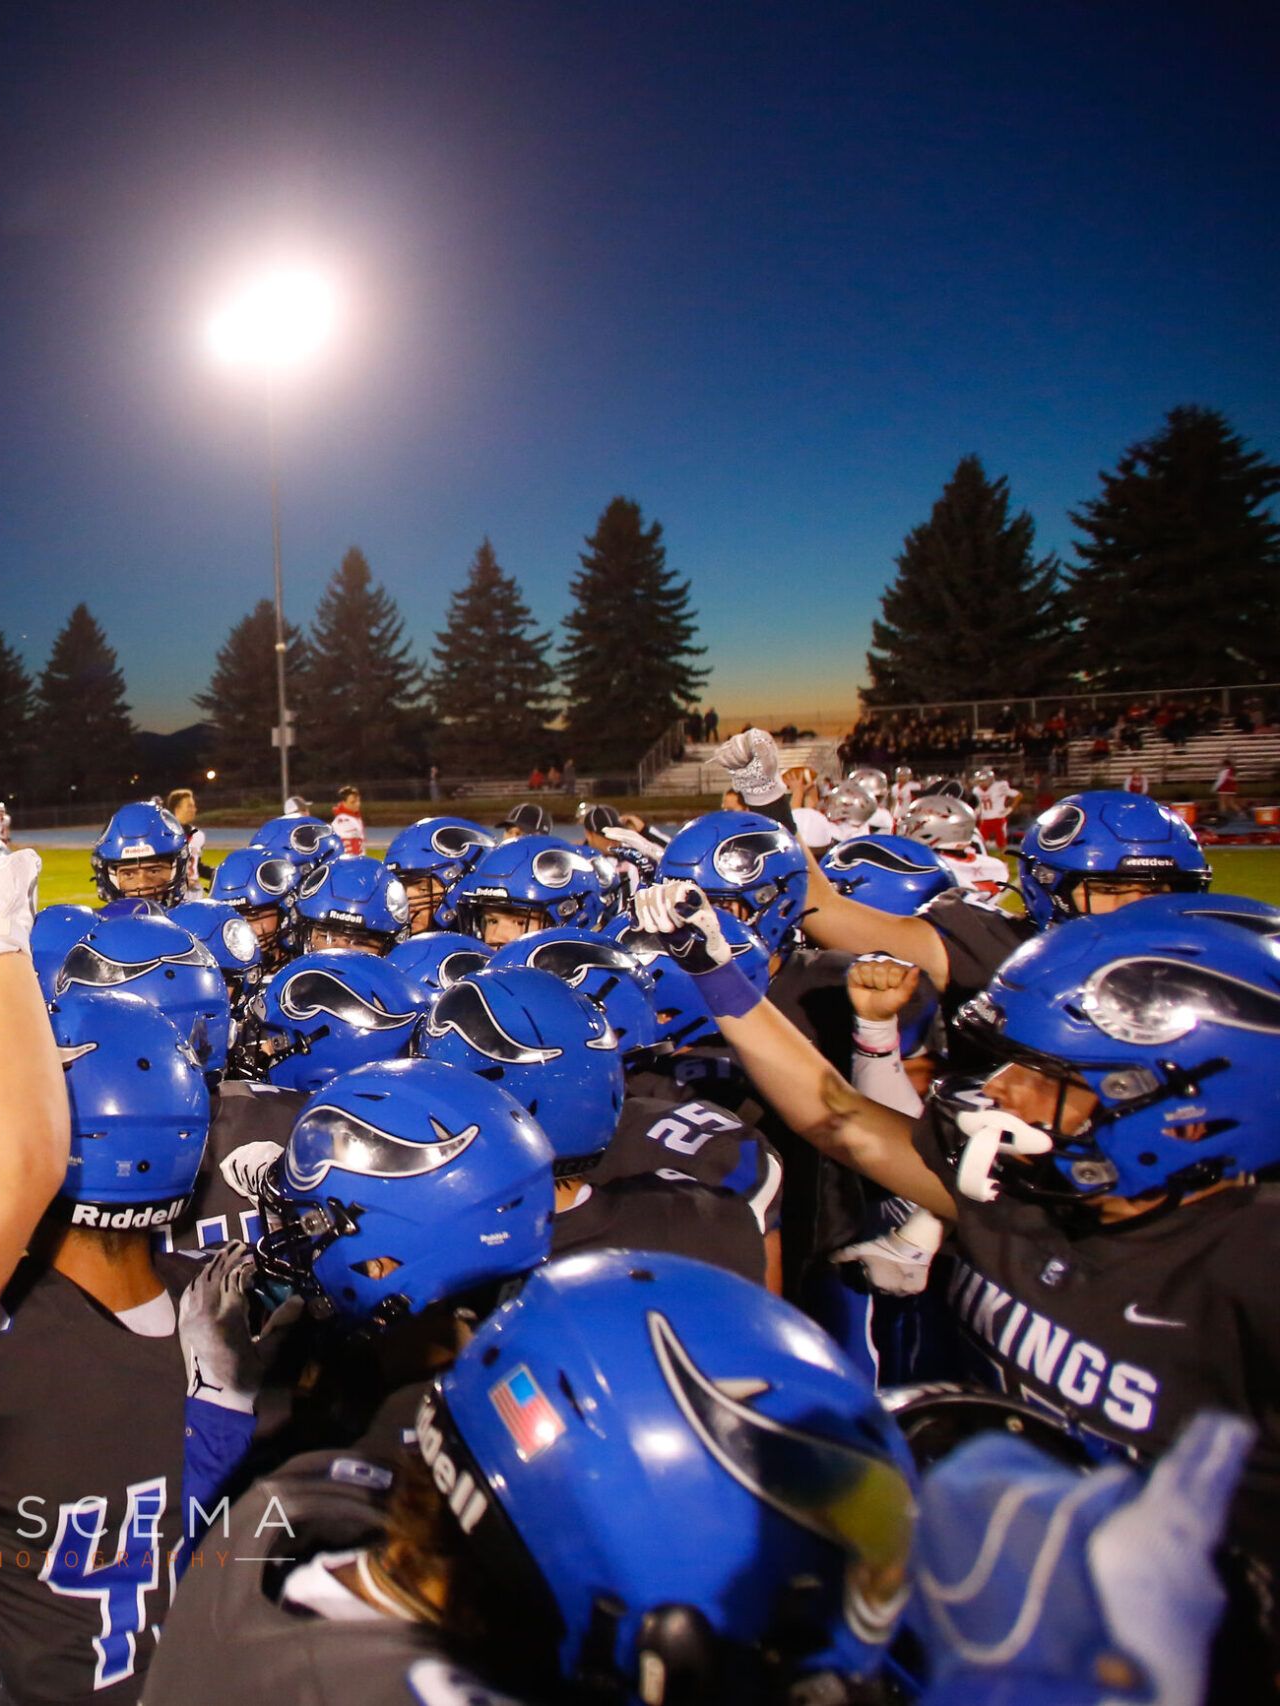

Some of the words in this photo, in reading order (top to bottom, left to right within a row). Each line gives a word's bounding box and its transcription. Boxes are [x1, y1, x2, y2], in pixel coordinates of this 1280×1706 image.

[329, 910, 363, 924] Riddell
[646, 1102, 743, 1155] 25
[72, 1203, 185, 1230] Riddell
